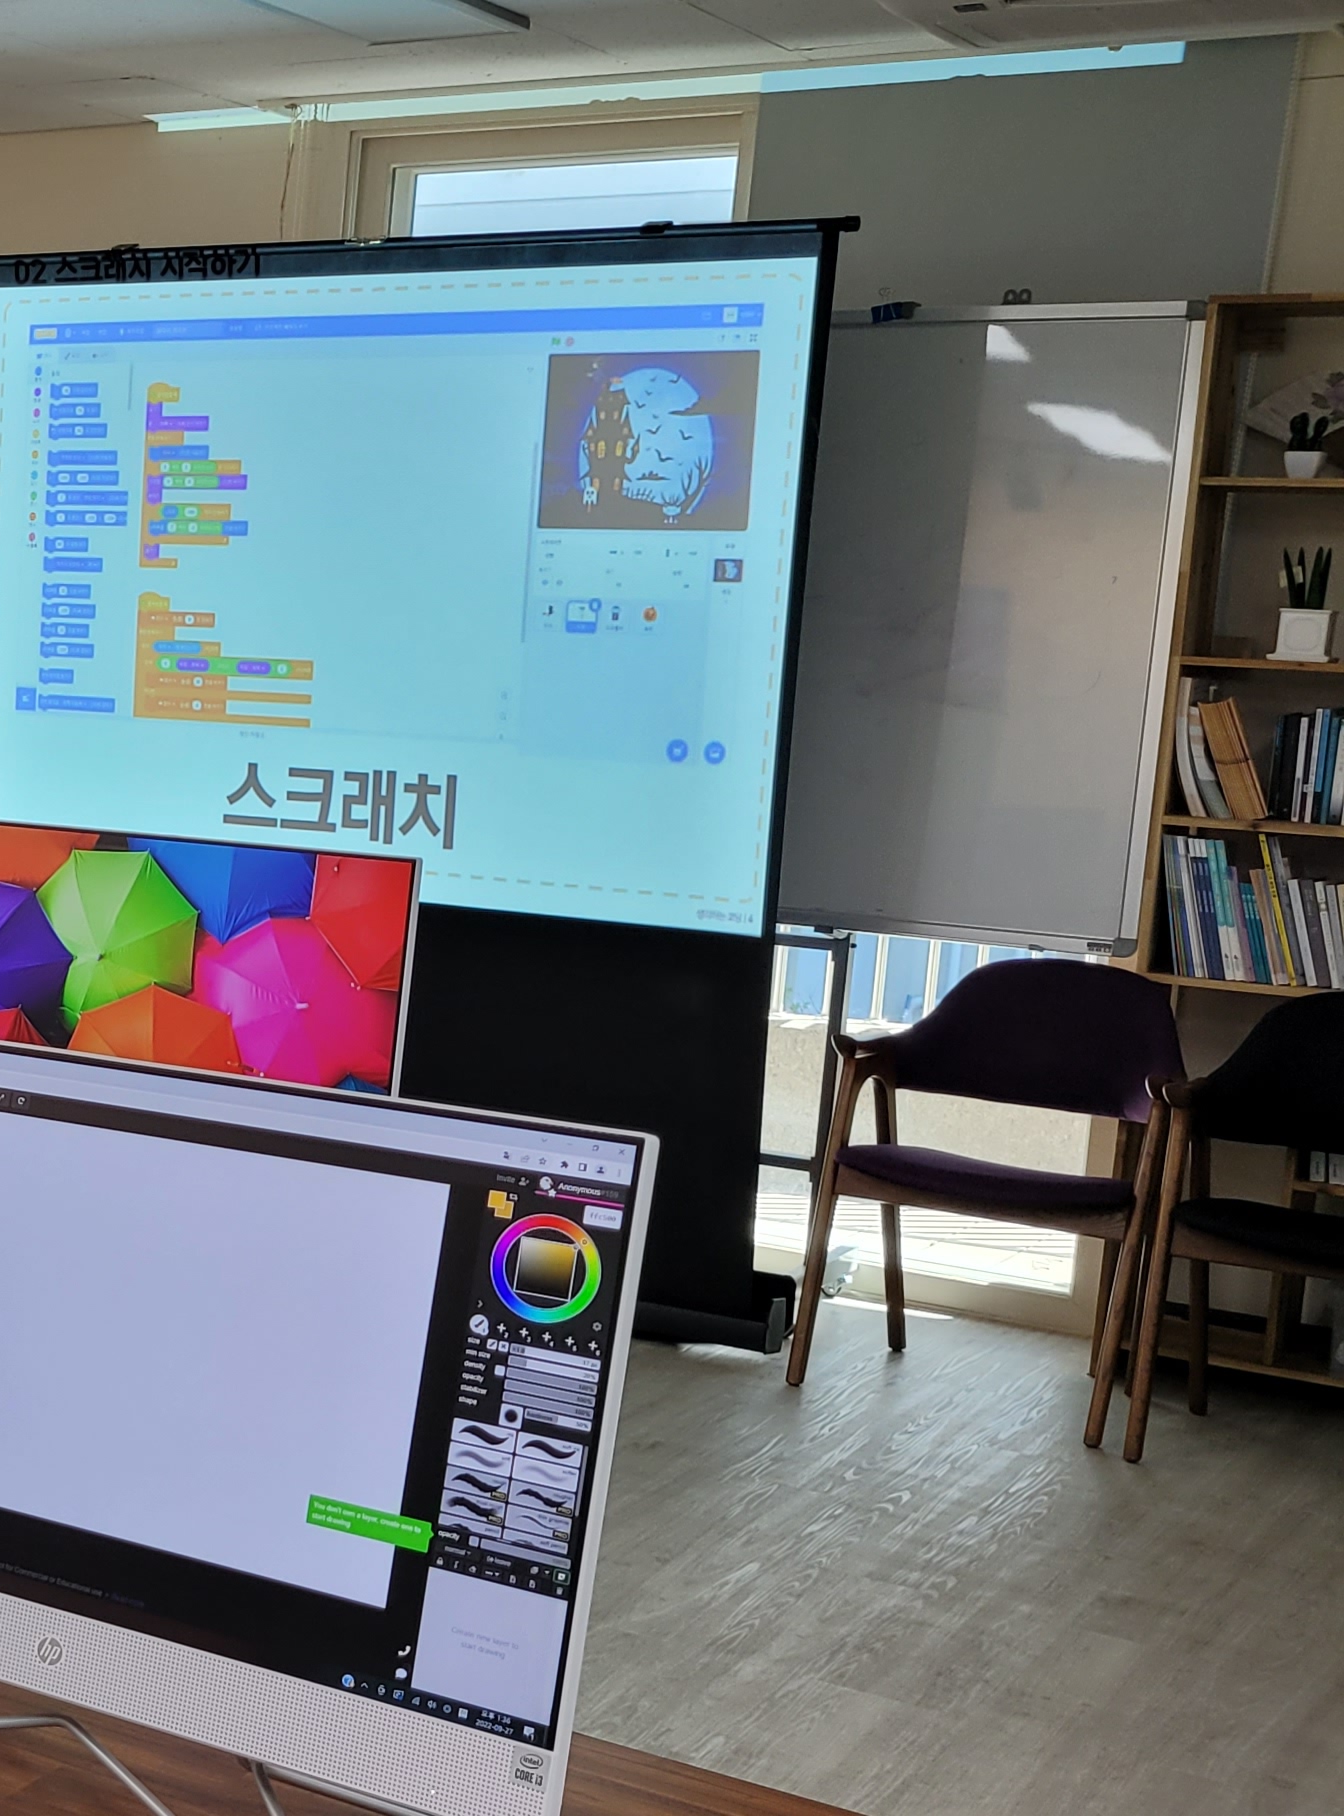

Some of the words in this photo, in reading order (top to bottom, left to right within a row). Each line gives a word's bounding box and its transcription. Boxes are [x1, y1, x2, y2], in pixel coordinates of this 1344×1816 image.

[14, 259, 47, 284] 02
[54, 252, 151, 283] 스크래치
[161, 247, 261, 278] 시작하기
[222, 762, 458, 850] 스크래치
[464, 1360, 486, 1371] density
[462, 1372, 484, 1383] opacity
[437, 1530, 460, 1541] opacity
[451, 1626, 473, 1639] Create
[39, 1637, 62, 1666] hp
[475, 1718, 513, 1734] 2022-09-27
[523, 1755, 541, 1767] intel
[515, 1768, 533, 1784] CORE
[534, 1773, 543, 1786] i3
